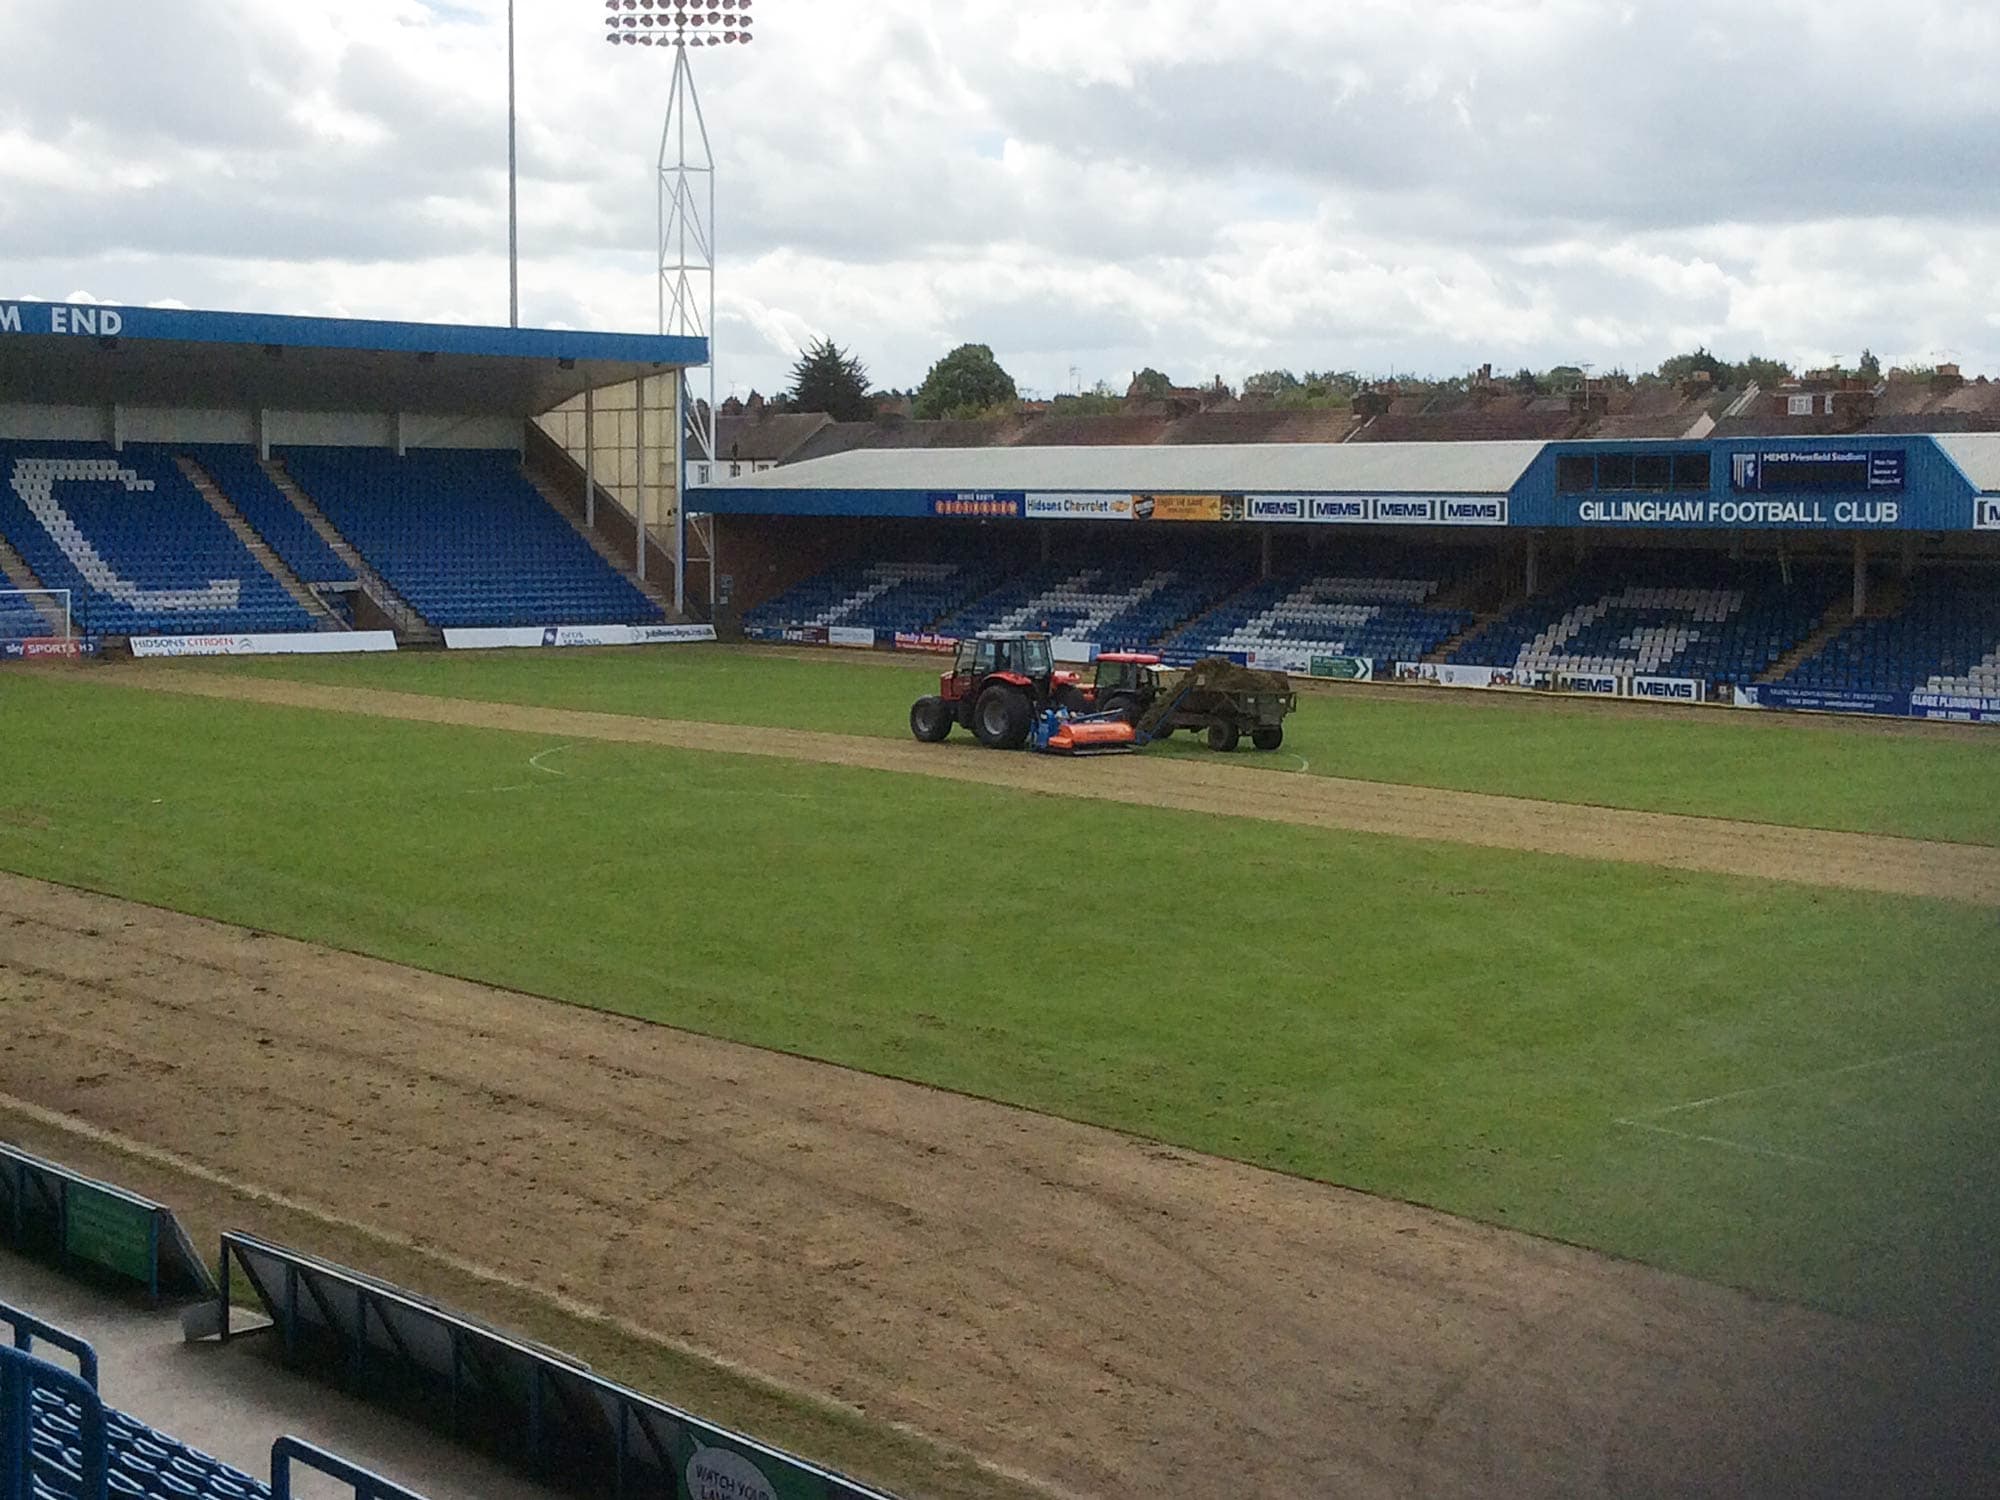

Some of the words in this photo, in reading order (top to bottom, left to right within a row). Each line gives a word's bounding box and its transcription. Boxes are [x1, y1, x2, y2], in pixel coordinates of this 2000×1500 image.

[52, 307, 122, 335] END
[1028, 500, 1061, 512] Hidsons
[1064, 500, 1108, 512] Chevrolet
[1254, 502, 1297, 515] MEMS
[1316, 503, 1362, 516] MEMS
[1380, 503, 1427, 517] MEMS
[1447, 504, 1497, 518] MEMS
[1579, 502, 1703, 522] GILLINGHAM
[1708, 502, 1827, 522] FOOTBALL
[1834, 502, 1898, 523] CLUB
[6, 644, 24, 655] sky
[28, 644, 77, 654] SPORTS
[1561, 677, 1613, 693] MEMS
[1637, 680, 1692, 698] MEMS
[696, 1464, 735, 1491] WATCH
